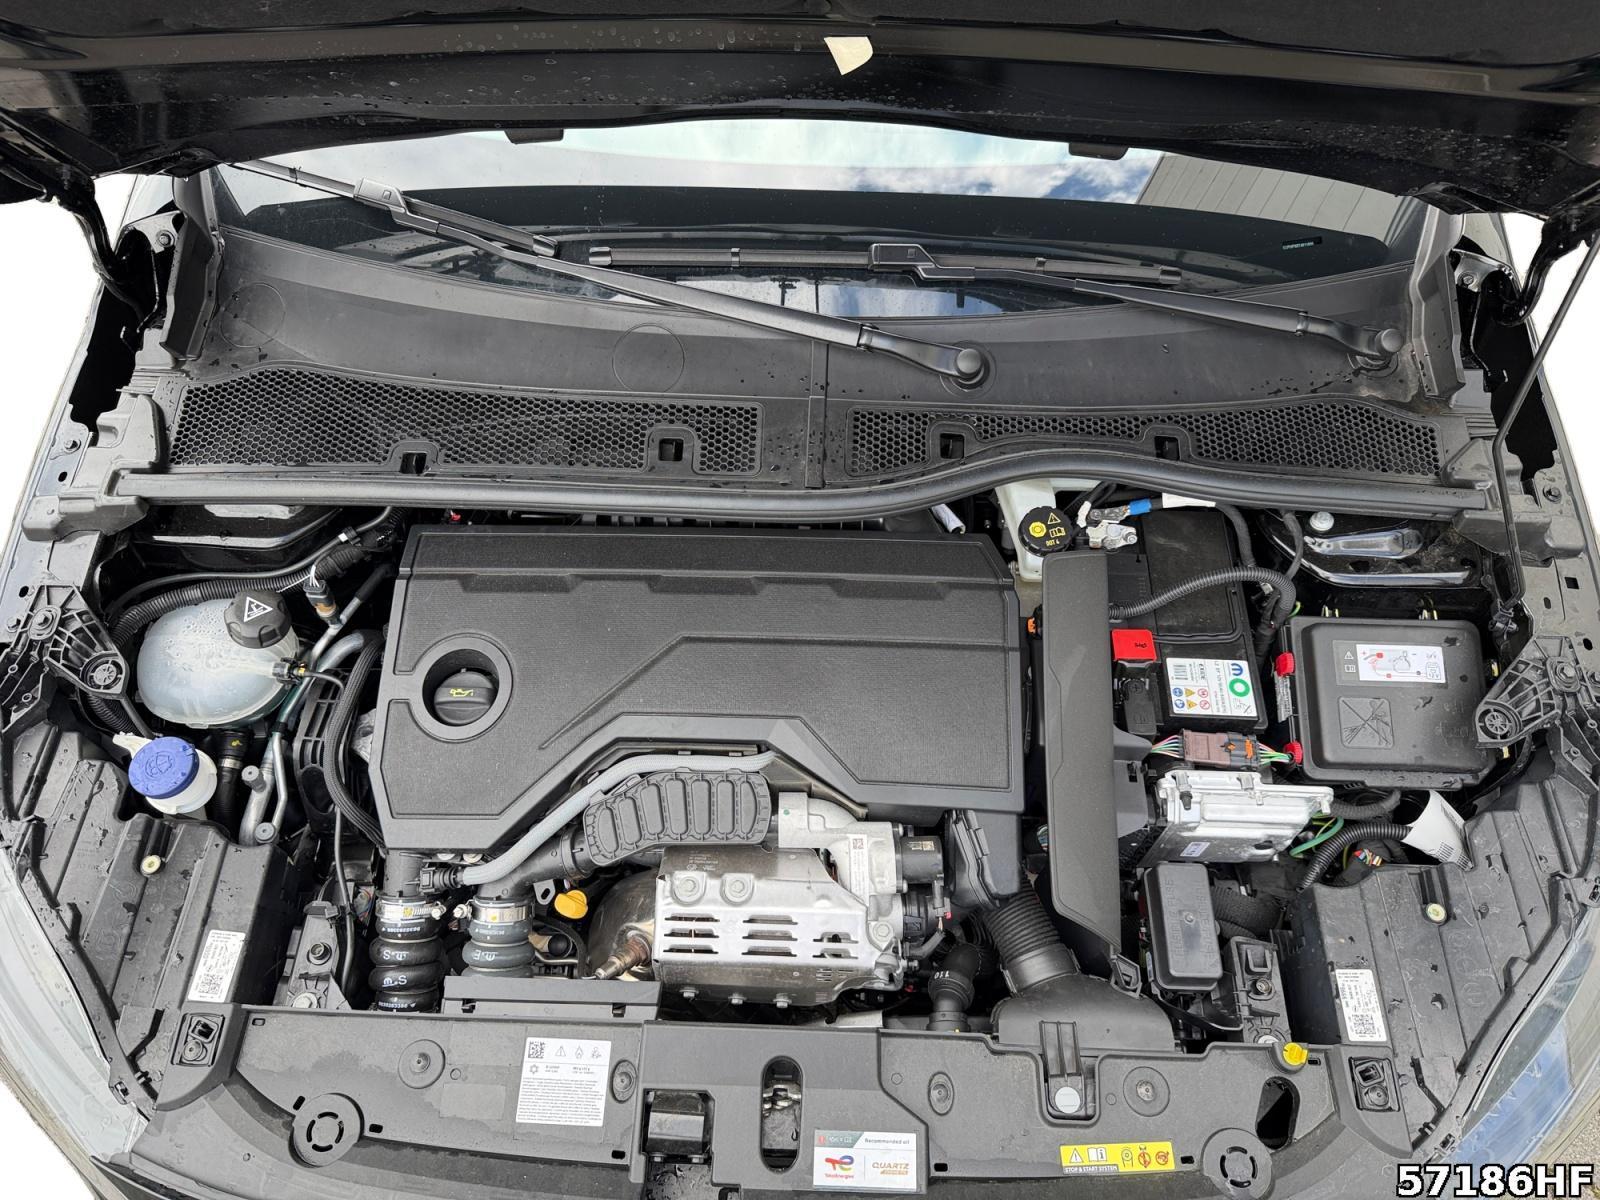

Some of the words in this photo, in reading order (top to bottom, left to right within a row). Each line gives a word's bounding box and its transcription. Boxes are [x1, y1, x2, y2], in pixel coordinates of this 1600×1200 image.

[871, 1161, 910, 1170] QUARTZ
[1064, 1166, 1078, 1174] STOP
[1099, 1164, 1118, 1172] SYSTEM
